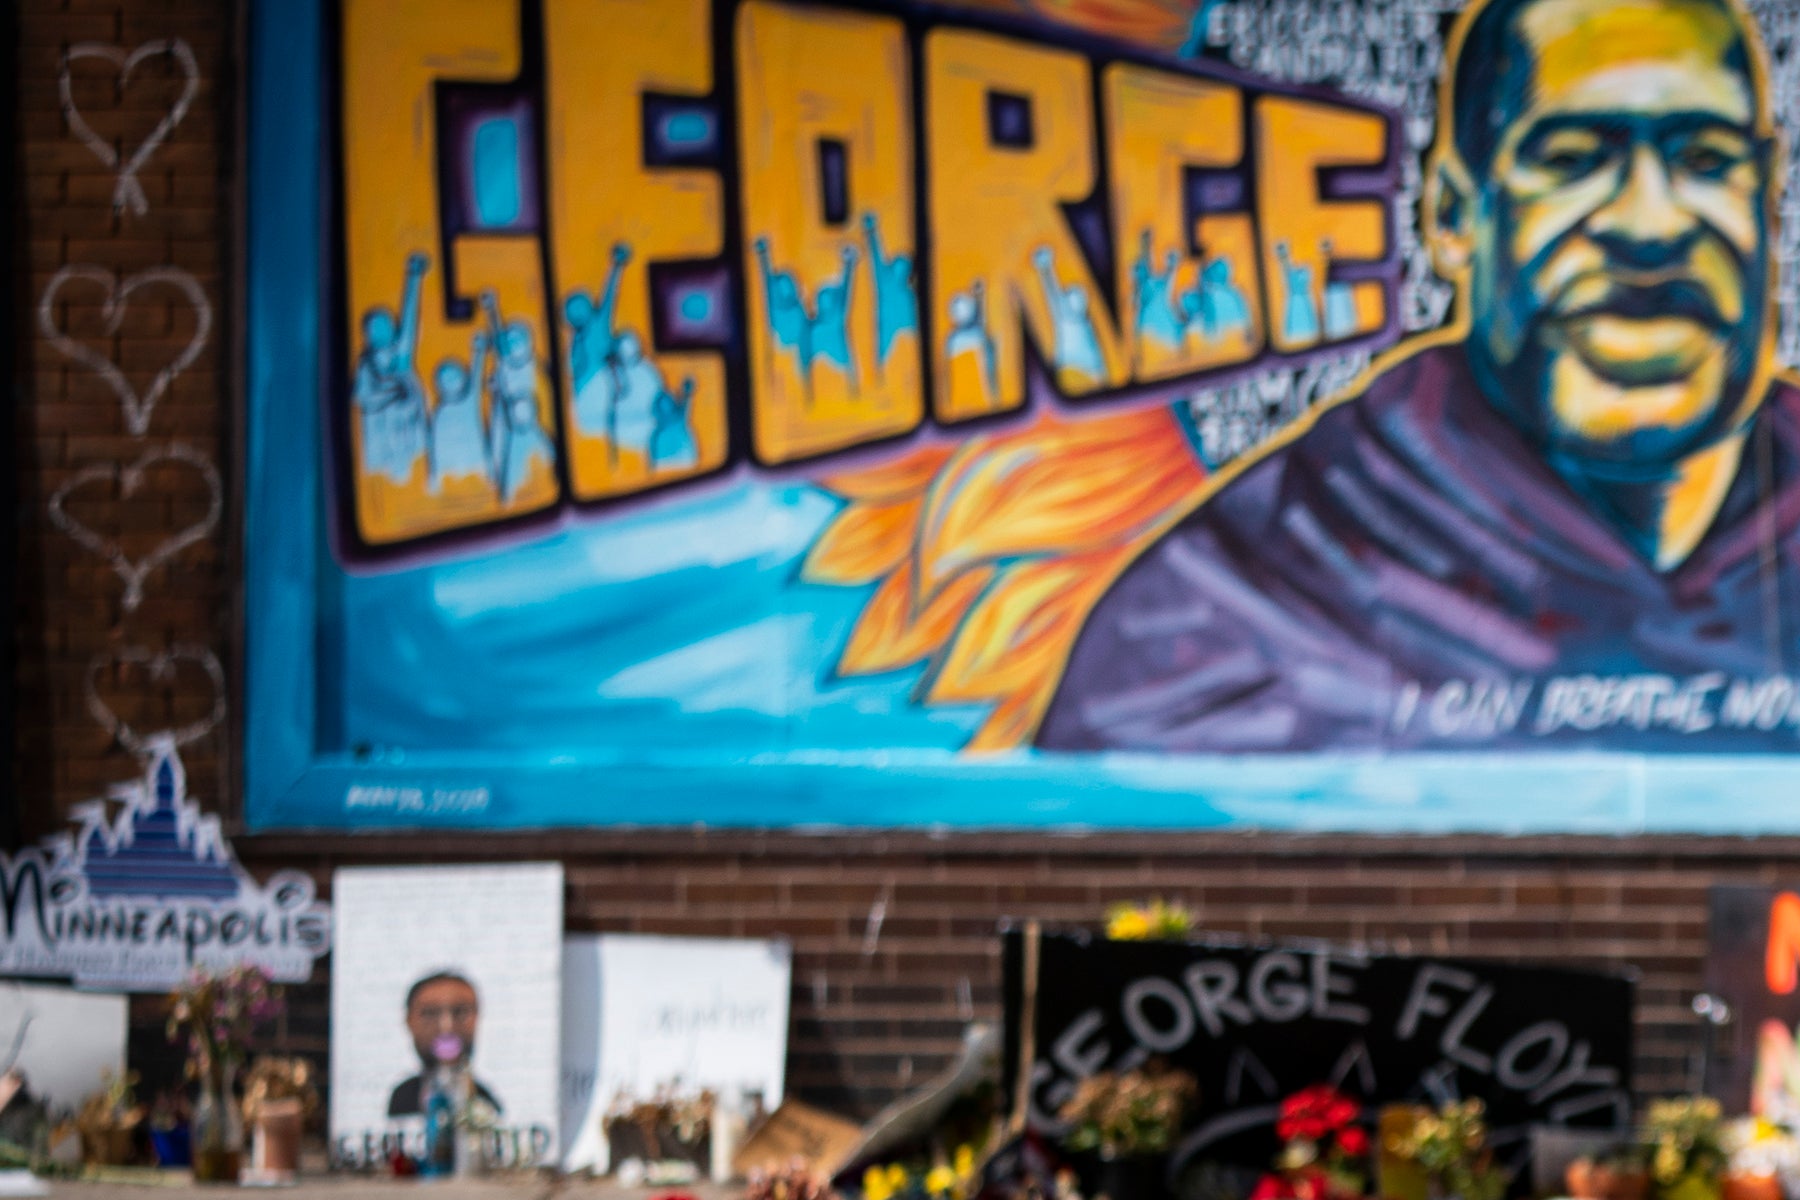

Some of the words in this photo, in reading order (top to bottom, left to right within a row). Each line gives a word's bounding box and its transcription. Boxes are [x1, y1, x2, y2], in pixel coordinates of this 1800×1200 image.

[345, 0, 1388, 546] GEORGE
[1025, 949, 1371, 1138] GEORGE
[1394, 961, 1631, 1129] FLOYD
